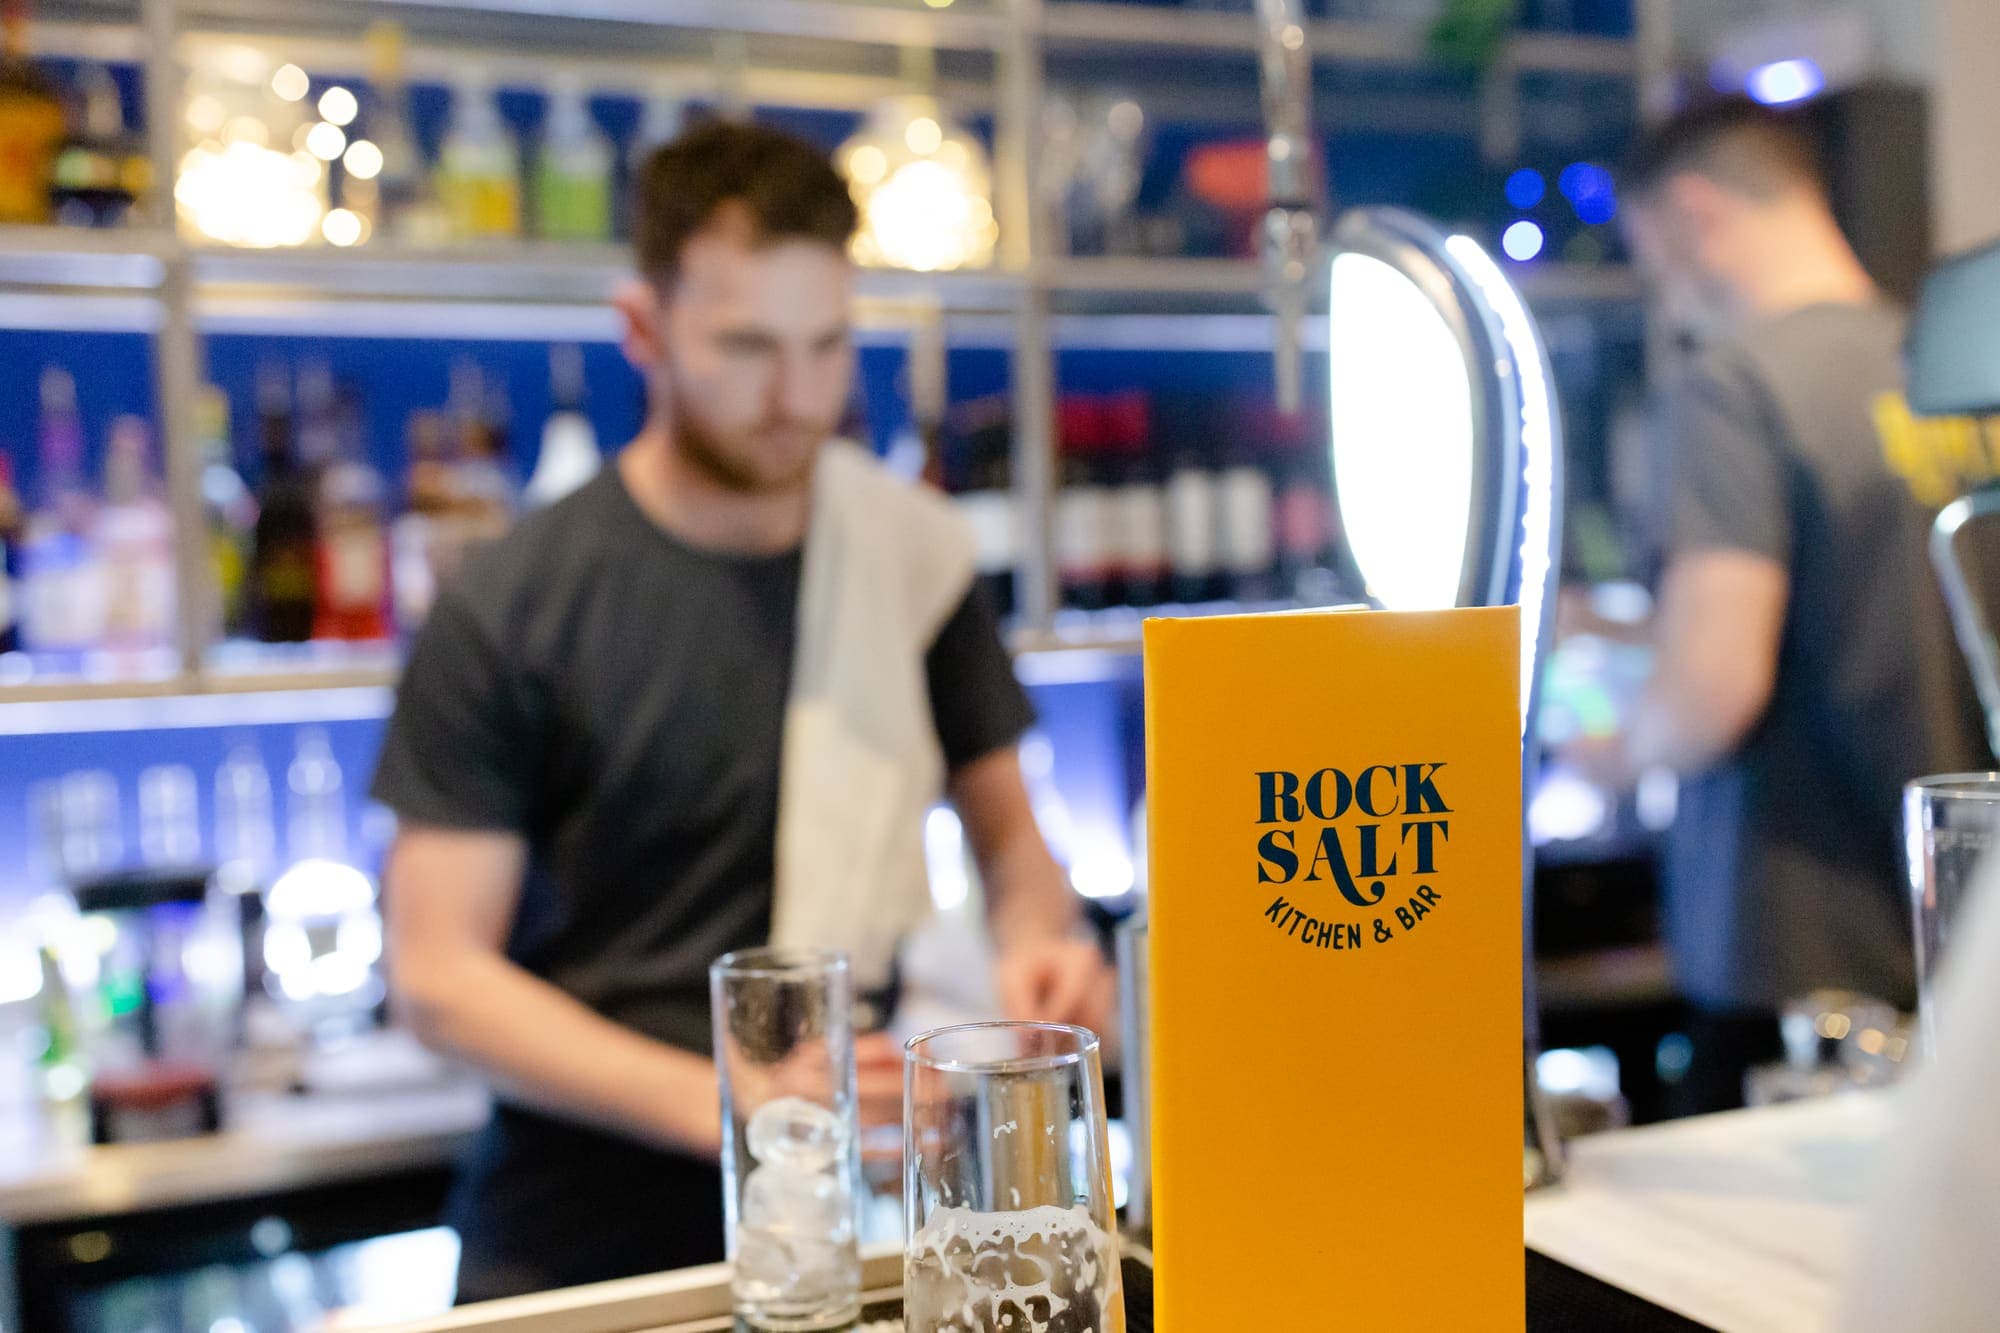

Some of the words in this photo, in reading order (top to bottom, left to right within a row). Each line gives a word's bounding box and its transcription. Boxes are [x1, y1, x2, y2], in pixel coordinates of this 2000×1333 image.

[1254, 762, 1455, 824] ROCK
[1257, 820, 1449, 907] SALT
[1264, 896, 1361, 950] KITCHEN
[1373, 918, 1393, 943] &
[1395, 884, 1442, 931] BAR
